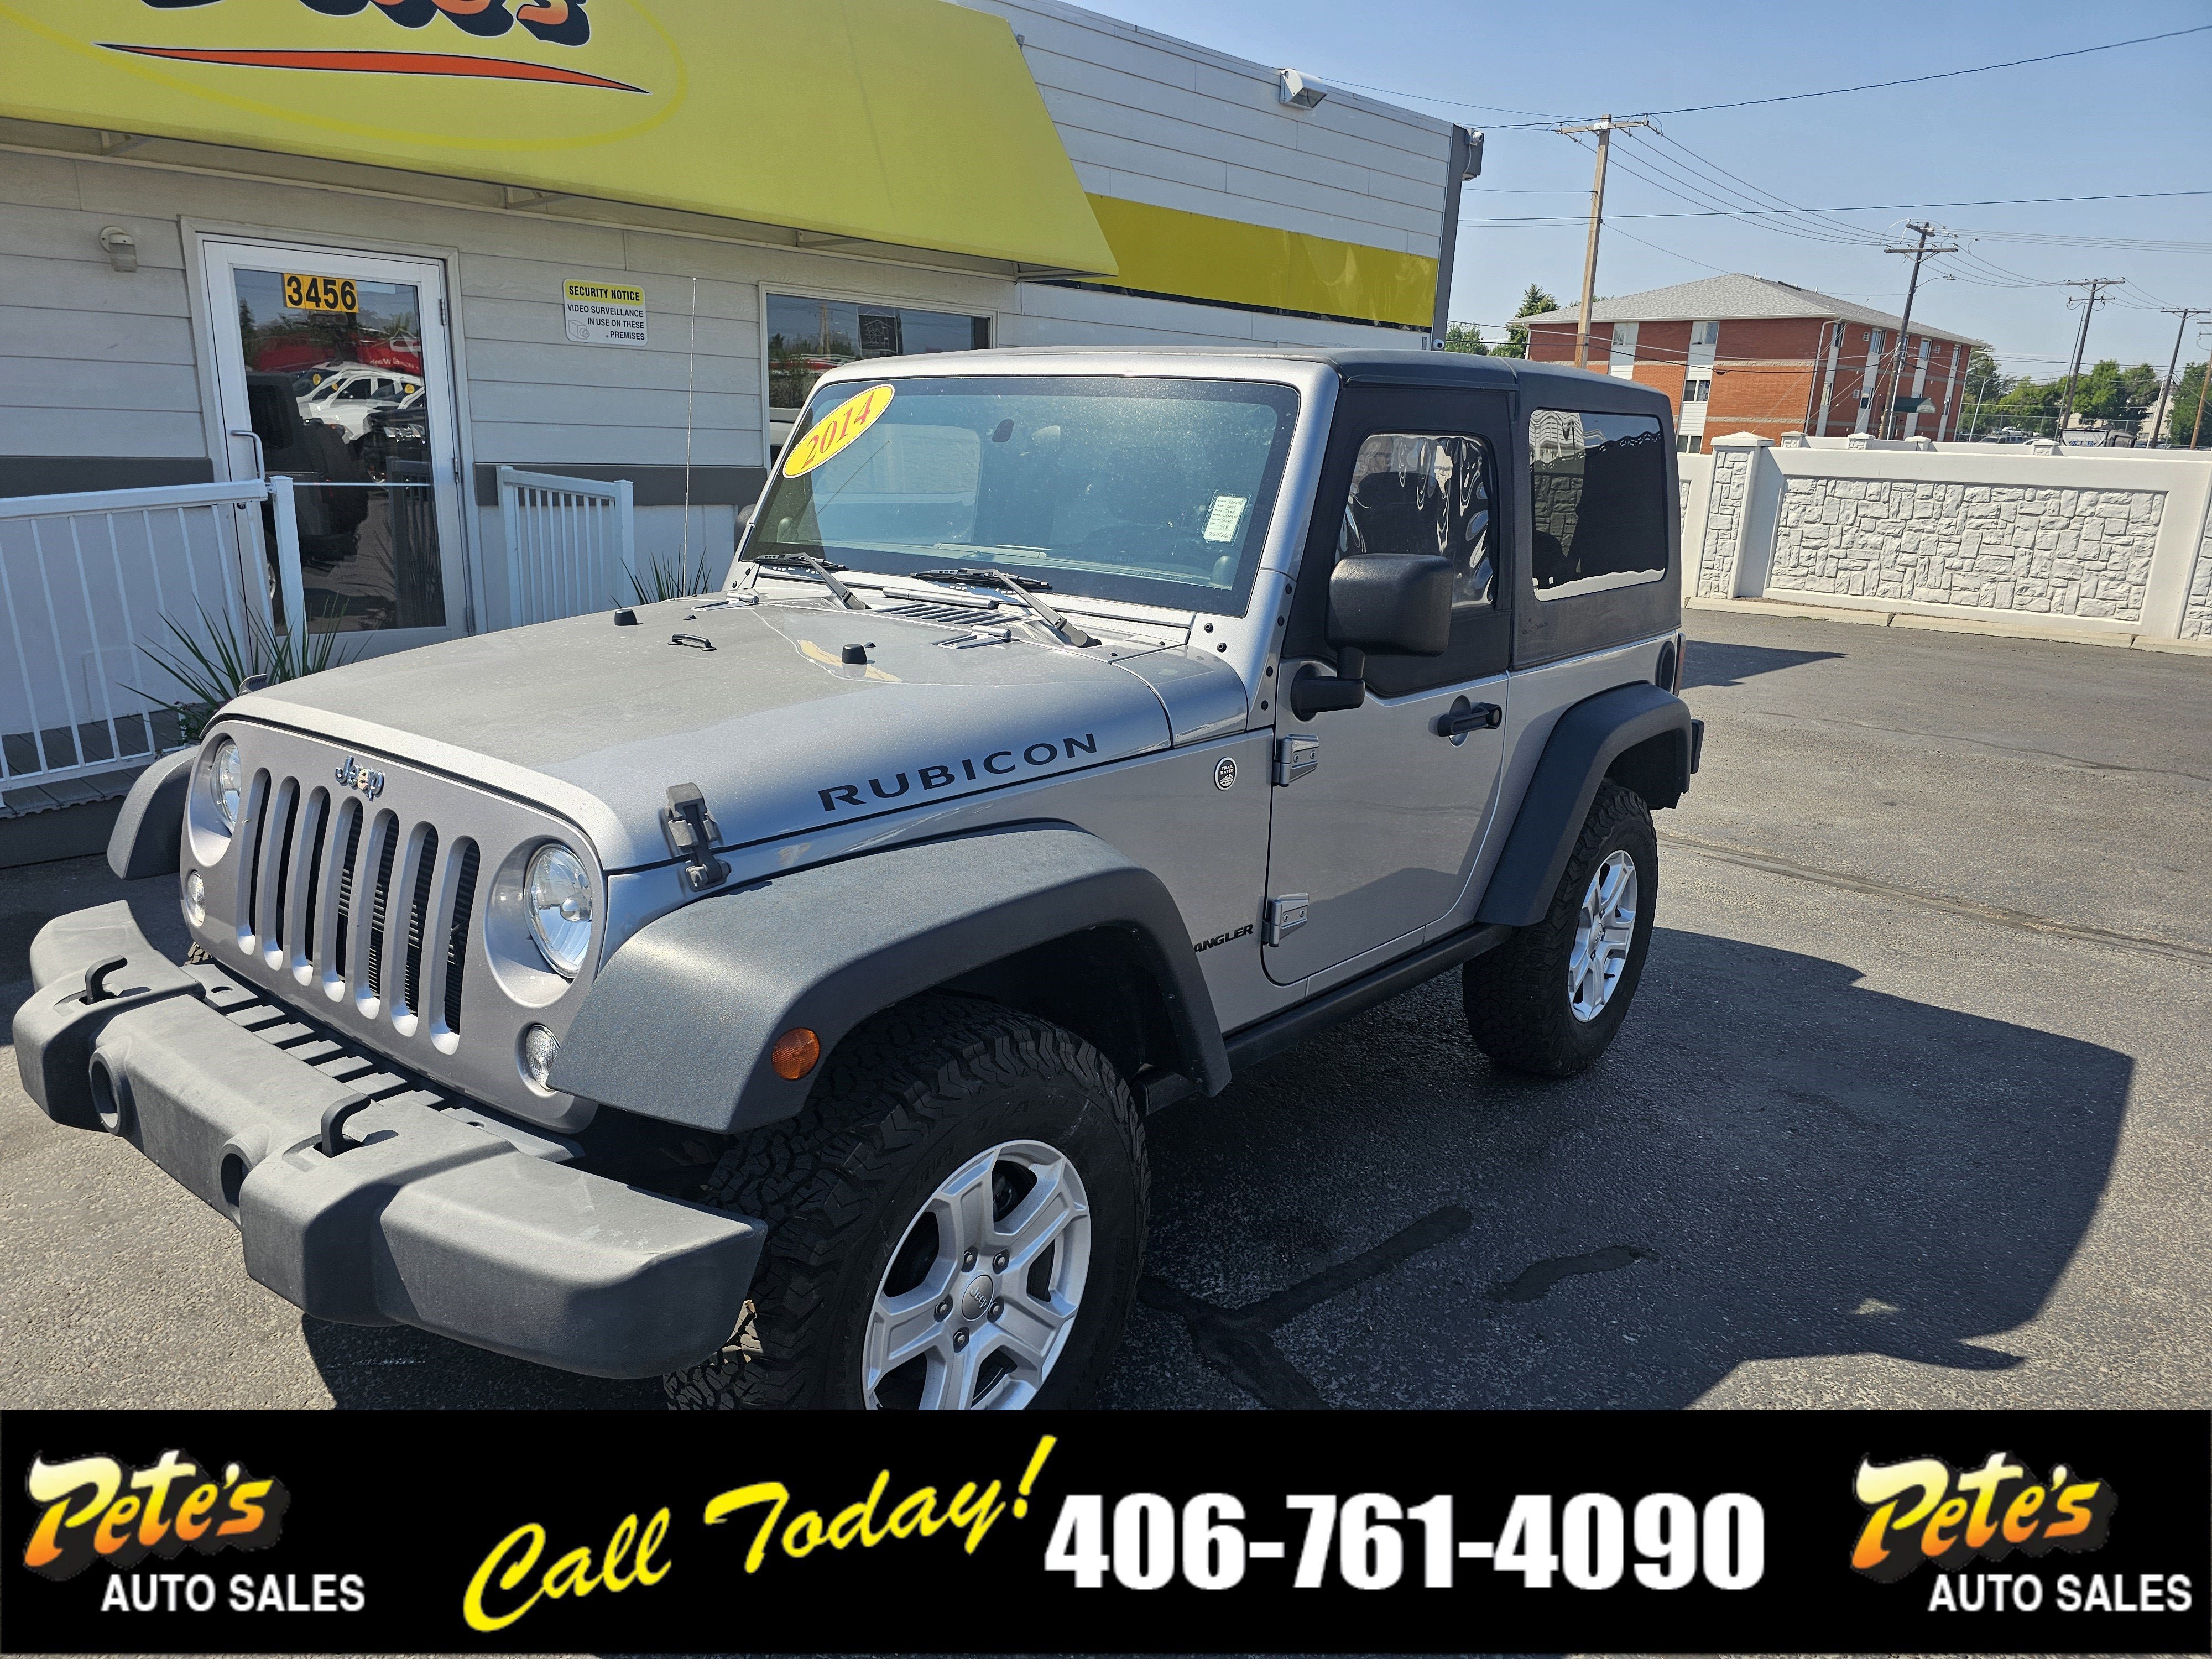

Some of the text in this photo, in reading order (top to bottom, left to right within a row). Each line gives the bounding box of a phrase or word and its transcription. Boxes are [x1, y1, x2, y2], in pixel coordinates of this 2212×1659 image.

[286, 275, 357, 311] 3456
[569, 285, 640, 301] SECURITY NOTICE
[567, 304, 644, 317] VIDEO SURVEILLANCE
[610, 331, 645, 341] PREMISES
[623, 320, 644, 328] THESE
[801, 392, 875, 470] 2014
[335, 755, 385, 802] Jeep
[818, 733, 1097, 812] RUBICON
[1194, 924, 1254, 953] ANGLER
[970, 1287, 987, 1308] Jeep
